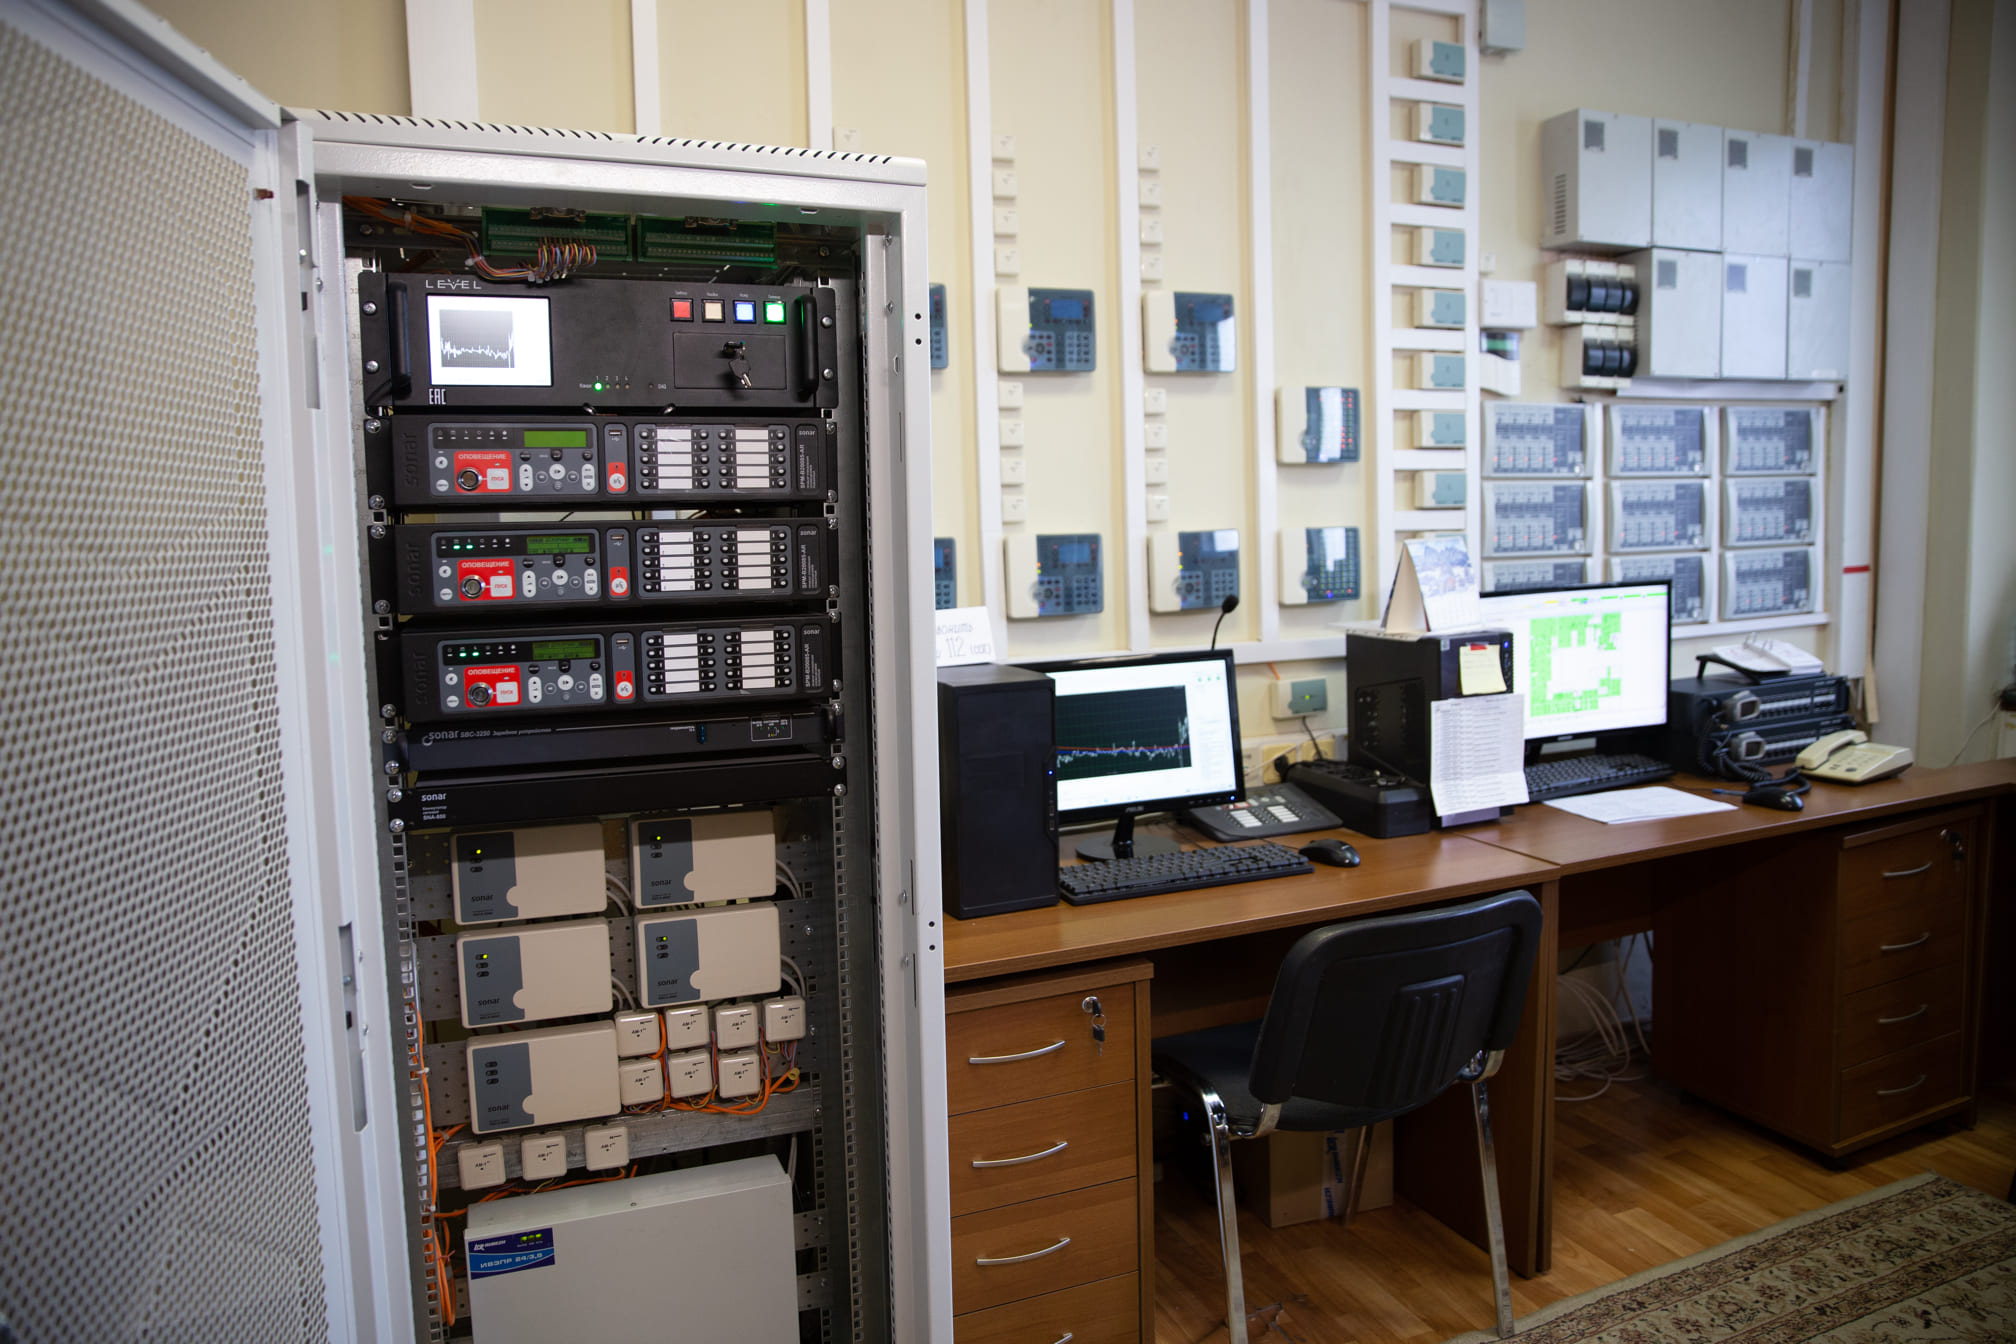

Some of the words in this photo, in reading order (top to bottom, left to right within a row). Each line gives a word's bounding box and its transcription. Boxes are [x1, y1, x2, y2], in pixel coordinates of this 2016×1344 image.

[425, 279, 482, 290] LEVEL
[428, 388, 447, 405] EAC
[458, 453, 507, 461] ОПОВЕЩЕНИЕ
[461, 561, 510, 569] ОПОВЕЩЕНИЕ
[467, 667, 516, 676] ОПОВЕЩЕНИЕ
[428, 730, 460, 740] sonar
[421, 793, 447, 802] sonar
[651, 879, 673, 887] sonar
[471, 894, 494, 902] sonar
[657, 978, 678, 986] sonar
[478, 997, 501, 1006] sonar
[487, 1103, 509, 1112] sonar
